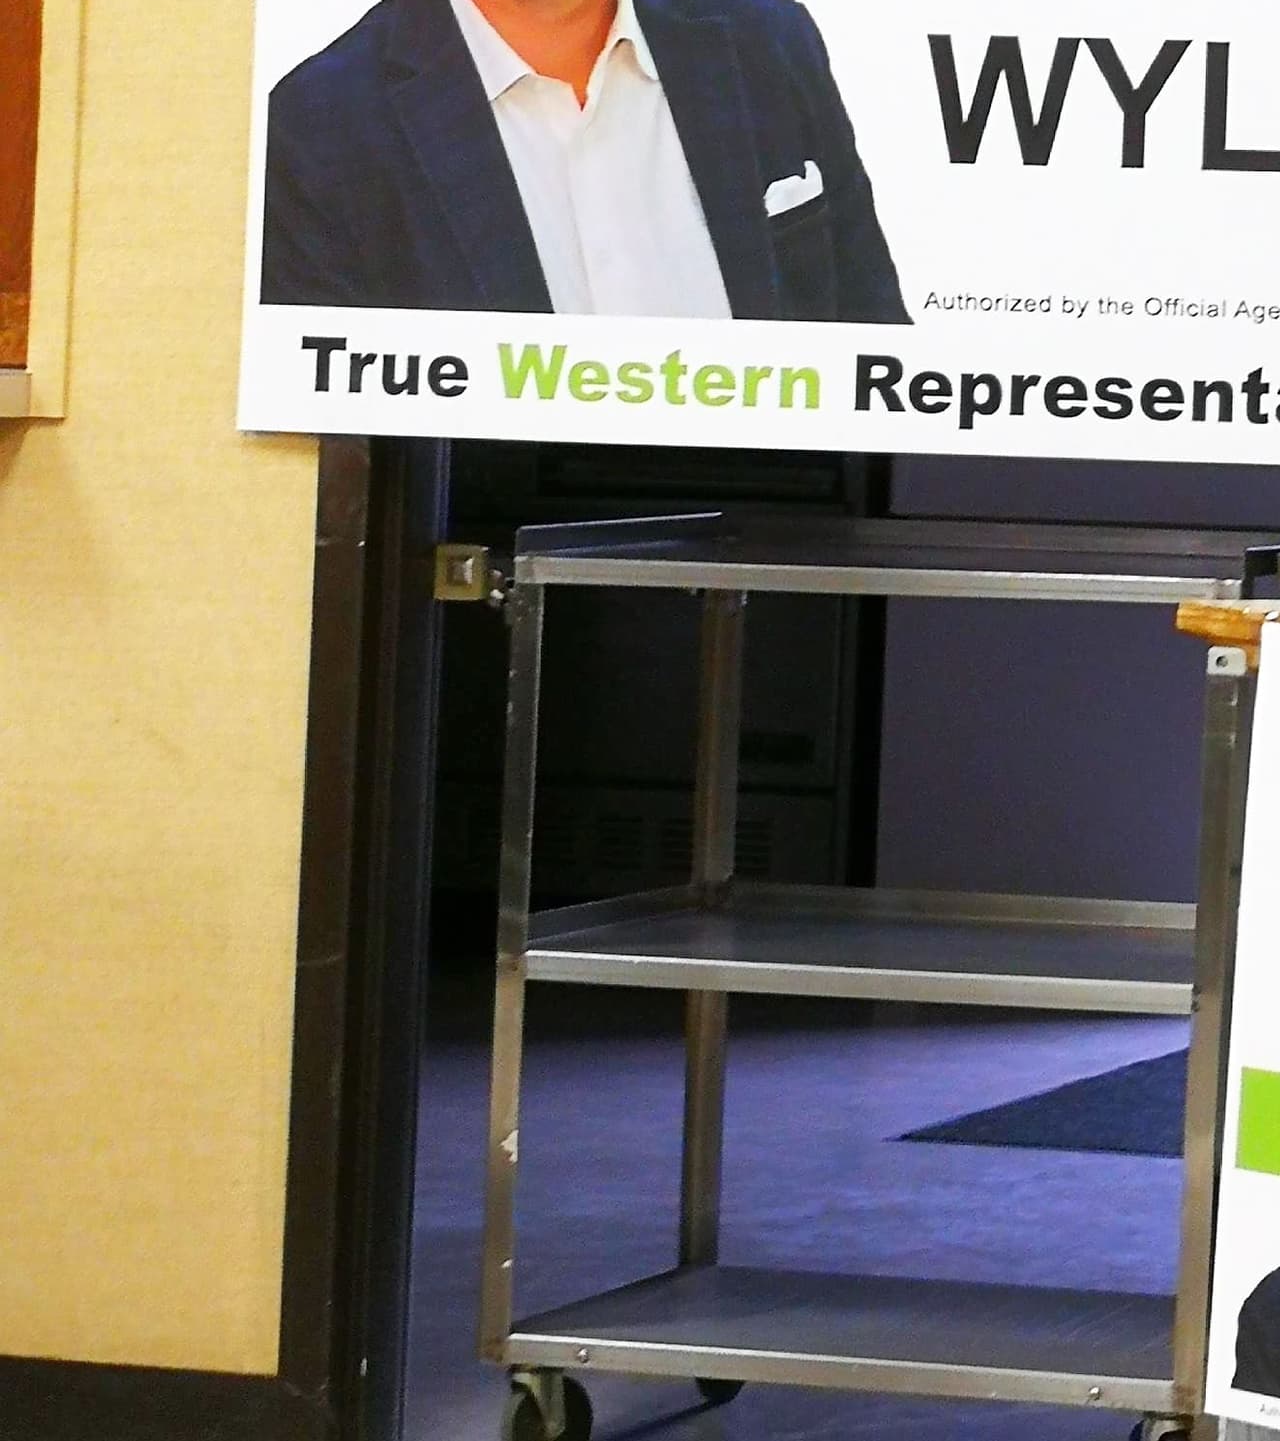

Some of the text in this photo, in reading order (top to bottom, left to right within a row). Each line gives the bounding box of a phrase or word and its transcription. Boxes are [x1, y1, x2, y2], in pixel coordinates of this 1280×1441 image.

[925, 293, 1052, 313] Authorized
[1063, 297, 1090, 319] by
[1099, 298, 1135, 316] the
[1146, 298, 1227, 319] Official
[303, 337, 469, 398] True
[500, 345, 821, 410] Western
